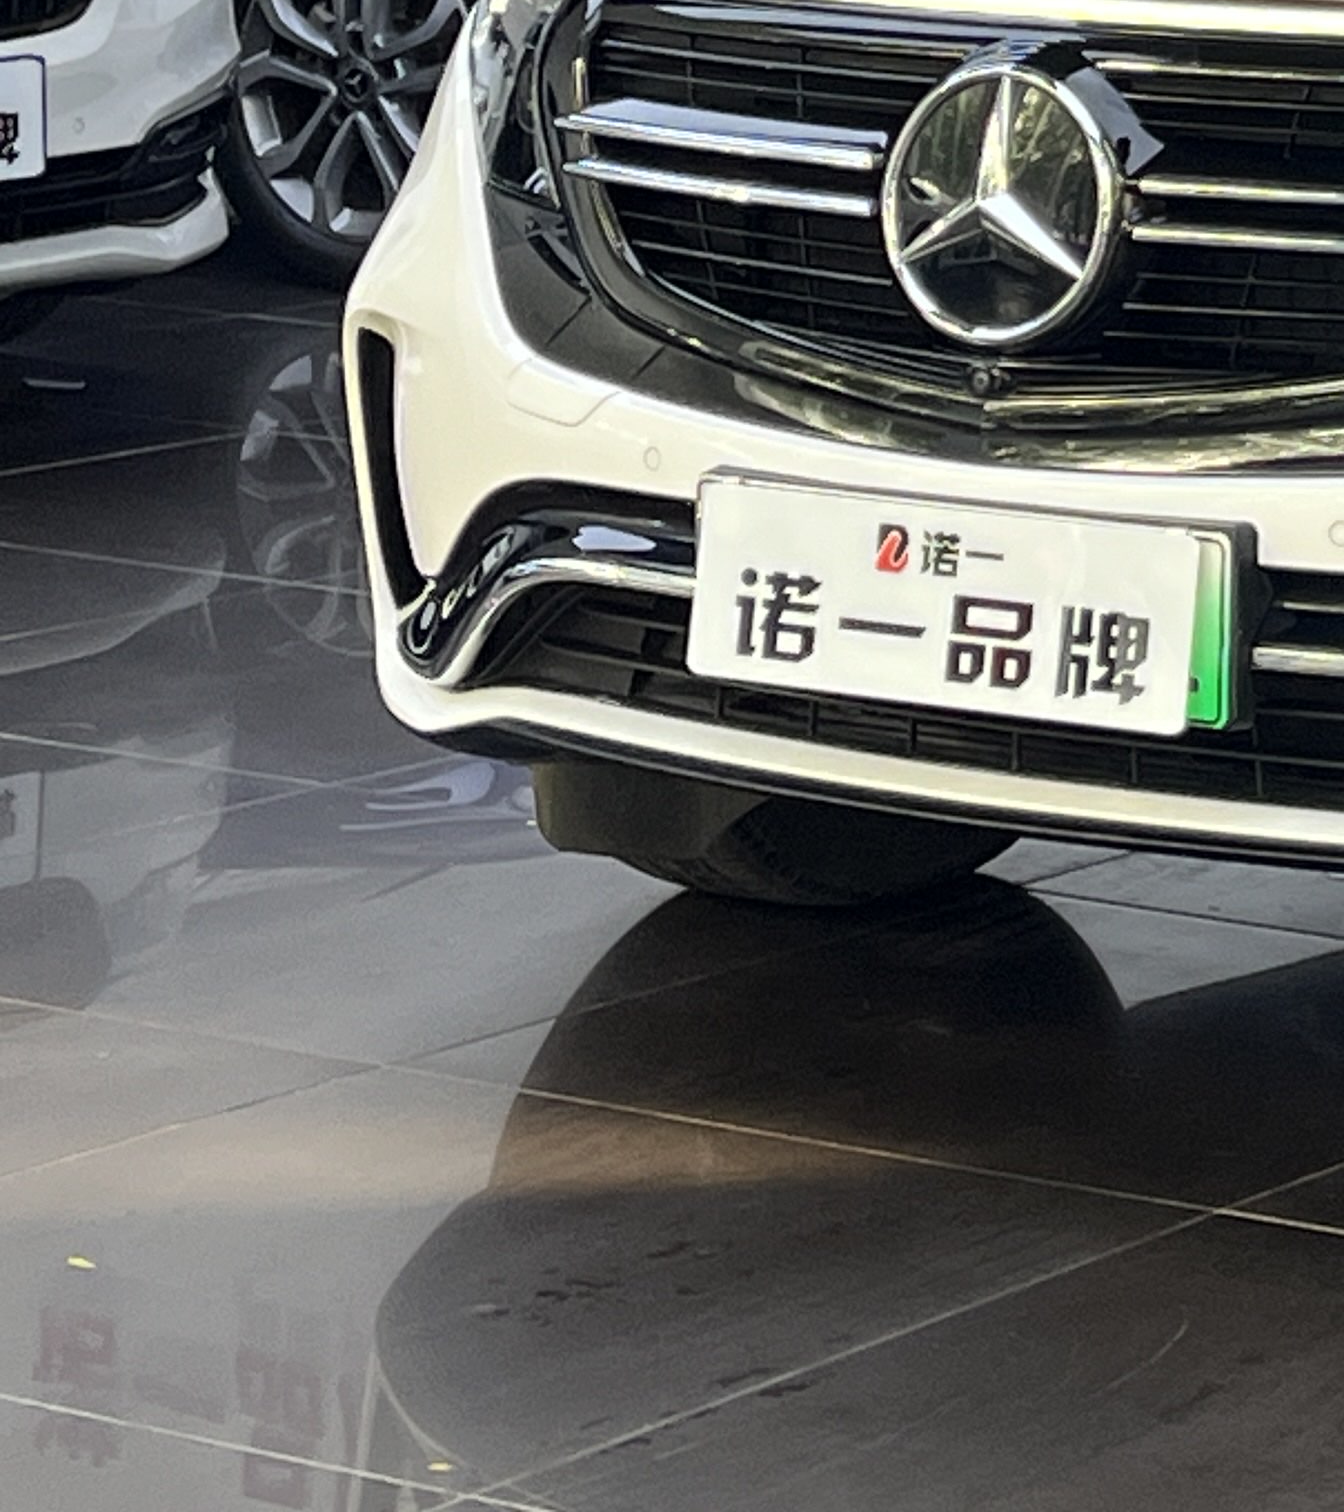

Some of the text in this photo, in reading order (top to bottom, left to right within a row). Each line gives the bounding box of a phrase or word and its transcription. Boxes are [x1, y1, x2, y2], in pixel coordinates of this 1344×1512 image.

[920, 530, 1004, 577] 诺一
[735, 567, 1151, 705] 诺一品牌
